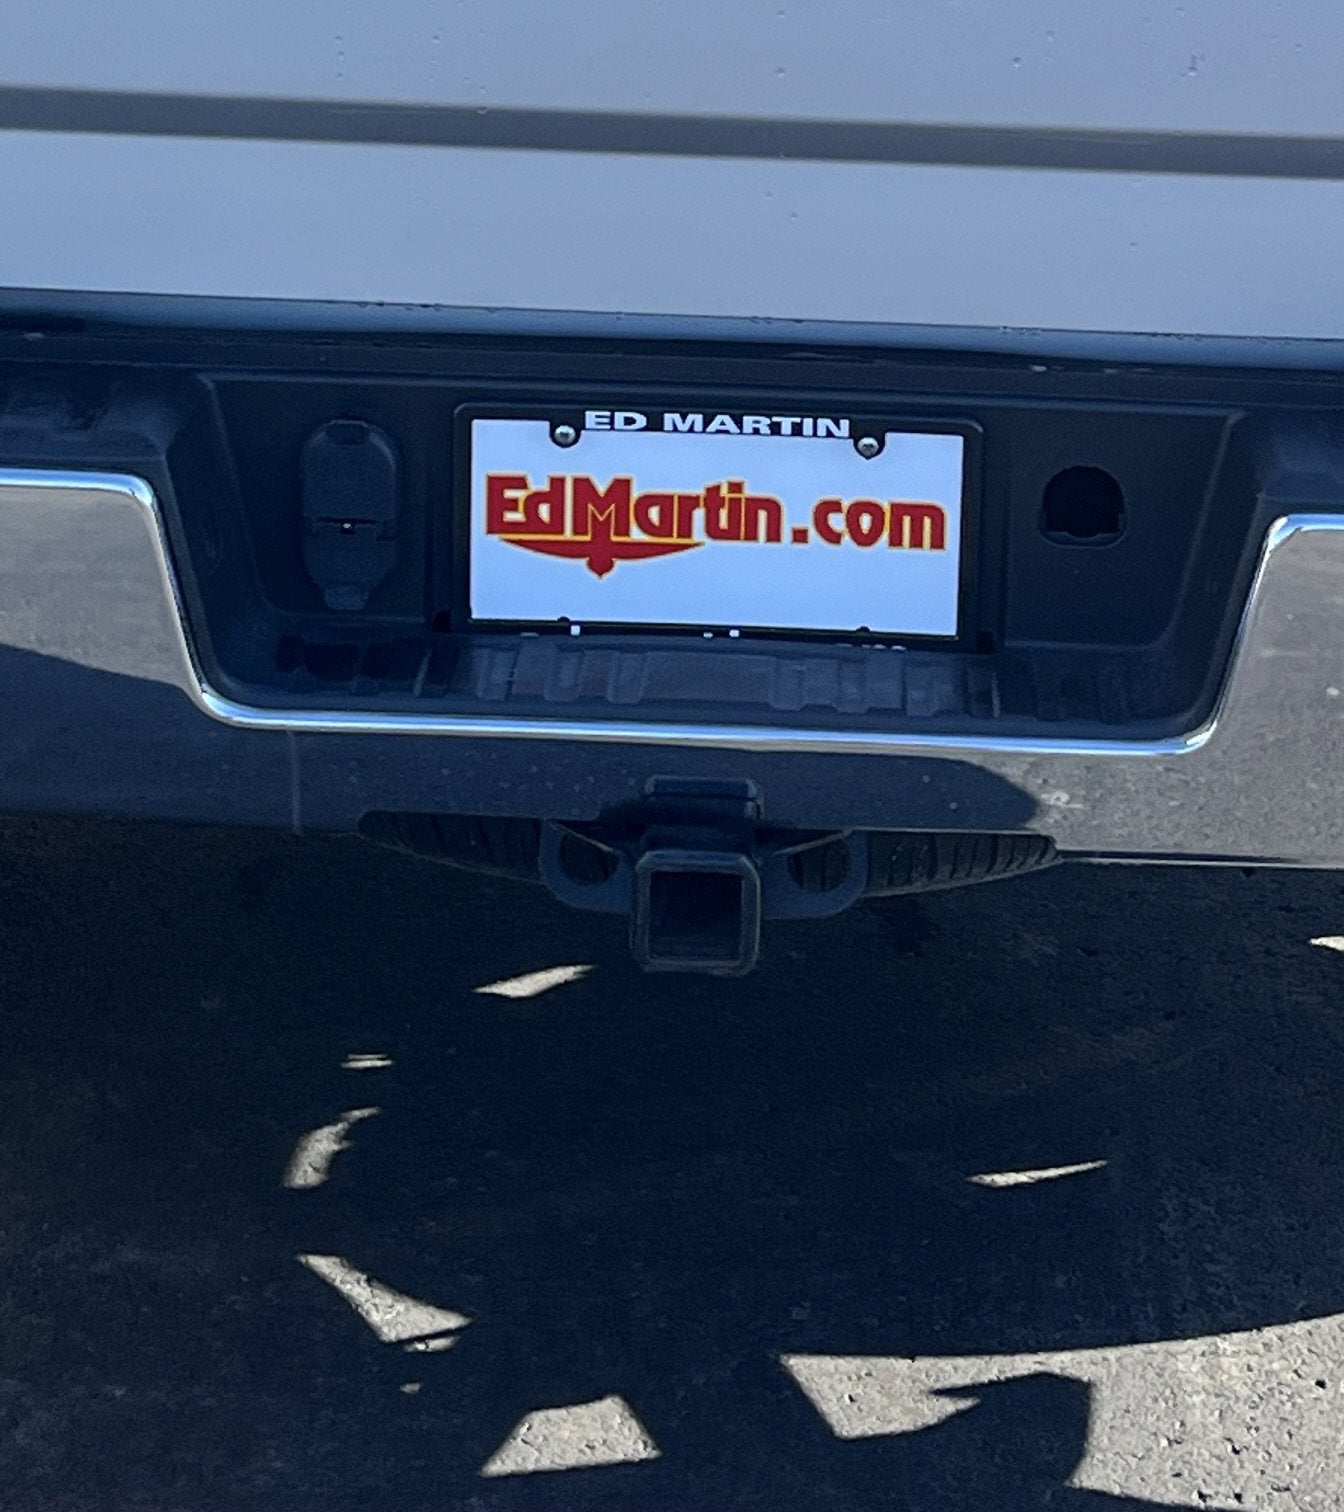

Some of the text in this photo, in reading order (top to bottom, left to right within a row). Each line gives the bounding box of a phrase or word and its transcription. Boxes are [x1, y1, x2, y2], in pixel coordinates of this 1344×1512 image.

[585, 411, 850, 438] ED MARTIN
[485, 474, 946, 551] EdMartin.com
